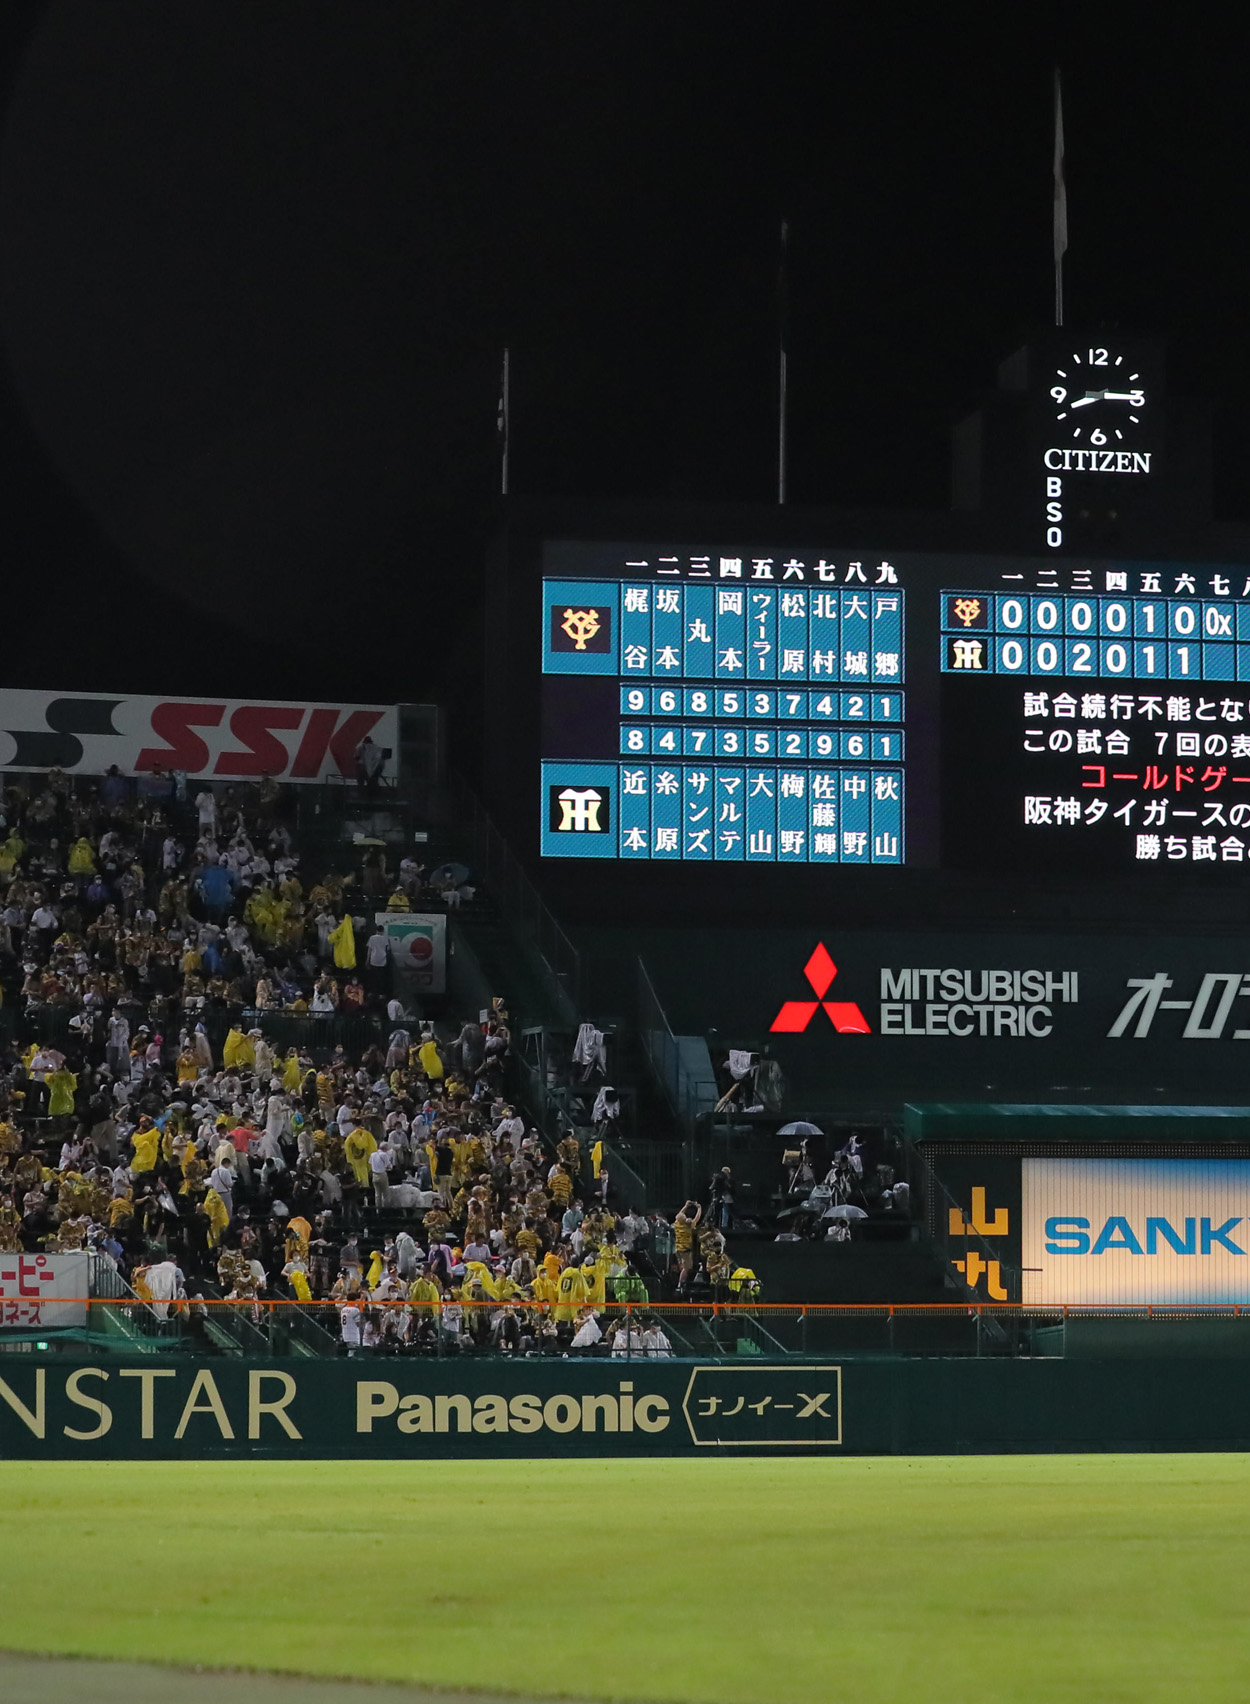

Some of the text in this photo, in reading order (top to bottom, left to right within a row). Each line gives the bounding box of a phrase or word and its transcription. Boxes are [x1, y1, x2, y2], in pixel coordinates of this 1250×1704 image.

[1089, 349, 1108, 365] 12
[1050, 387, 1066, 403] 9
[1129, 389, 1145, 407] 3
[1091, 429, 1107, 445] 6
[1044, 449, 1151, 473] CITIZEN
[1047, 477, 1061, 497] B
[1047, 502, 1062, 522] S
[1047, 527, 1061, 547] O
[657, 557, 679, 574] 二
[689, 557, 711, 576] 三
[720, 558, 741, 577] 四
[751, 559, 773, 578] 五
[783, 559, 804, 580] 六
[814, 560, 835, 581] 七
[845, 562, 866, 582] 八
[876, 562, 897, 583] 九
[1037, 571, 1058, 587] 二
[1071, 571, 1092, 589] 三
[1106, 572, 1127, 590] 四
[1140, 573, 1161, 592] 五
[1175, 575, 1195, 593] 六
[1209, 576, 1229, 595] 七
[1002, 600, 1022, 628] 0
[1037, 601, 1057, 629] 0
[1072, 603, 1091, 630] 0
[1106, 604, 1126, 631] 0
[1143, 605, 1153, 632] 1
[1175, 606, 1194, 634] 0
[1206, 607, 1231, 635] 0x
[625, 589, 898, 675] 梶谷 坂本 丸 岡本 ウィーラー 松原 北村 大城 戸郷
[1002, 641, 1022, 669] 0
[1037, 642, 1057, 670] 0
[1073, 643, 1091, 671] 2
[1106, 645, 1126, 672] 0
[1143, 646, 1154, 673] 1
[1177, 647, 1188, 674] 1
[629, 691, 889, 716] 9 6 8 5 3 7 4 2 1
[133, 702, 386, 779] SSK
[628, 730, 889, 756] 8 4 7 3 5 2 9 6 1
[1024, 729, 1130, 754] この試合
[624, 771, 898, 856] 近本 糸原 サンズ マルテ 大山 梅野 佐藤輝 中野 秋山
[881, 969, 1077, 1002] MITSUBISHI
[881, 1004, 1052, 1036] ELECTRIC
[0, 1255, 54, 1296] ーピー
[0, 1301, 45, 1325] ネーズ
[357, 1382, 669, 1433] Panasonic
